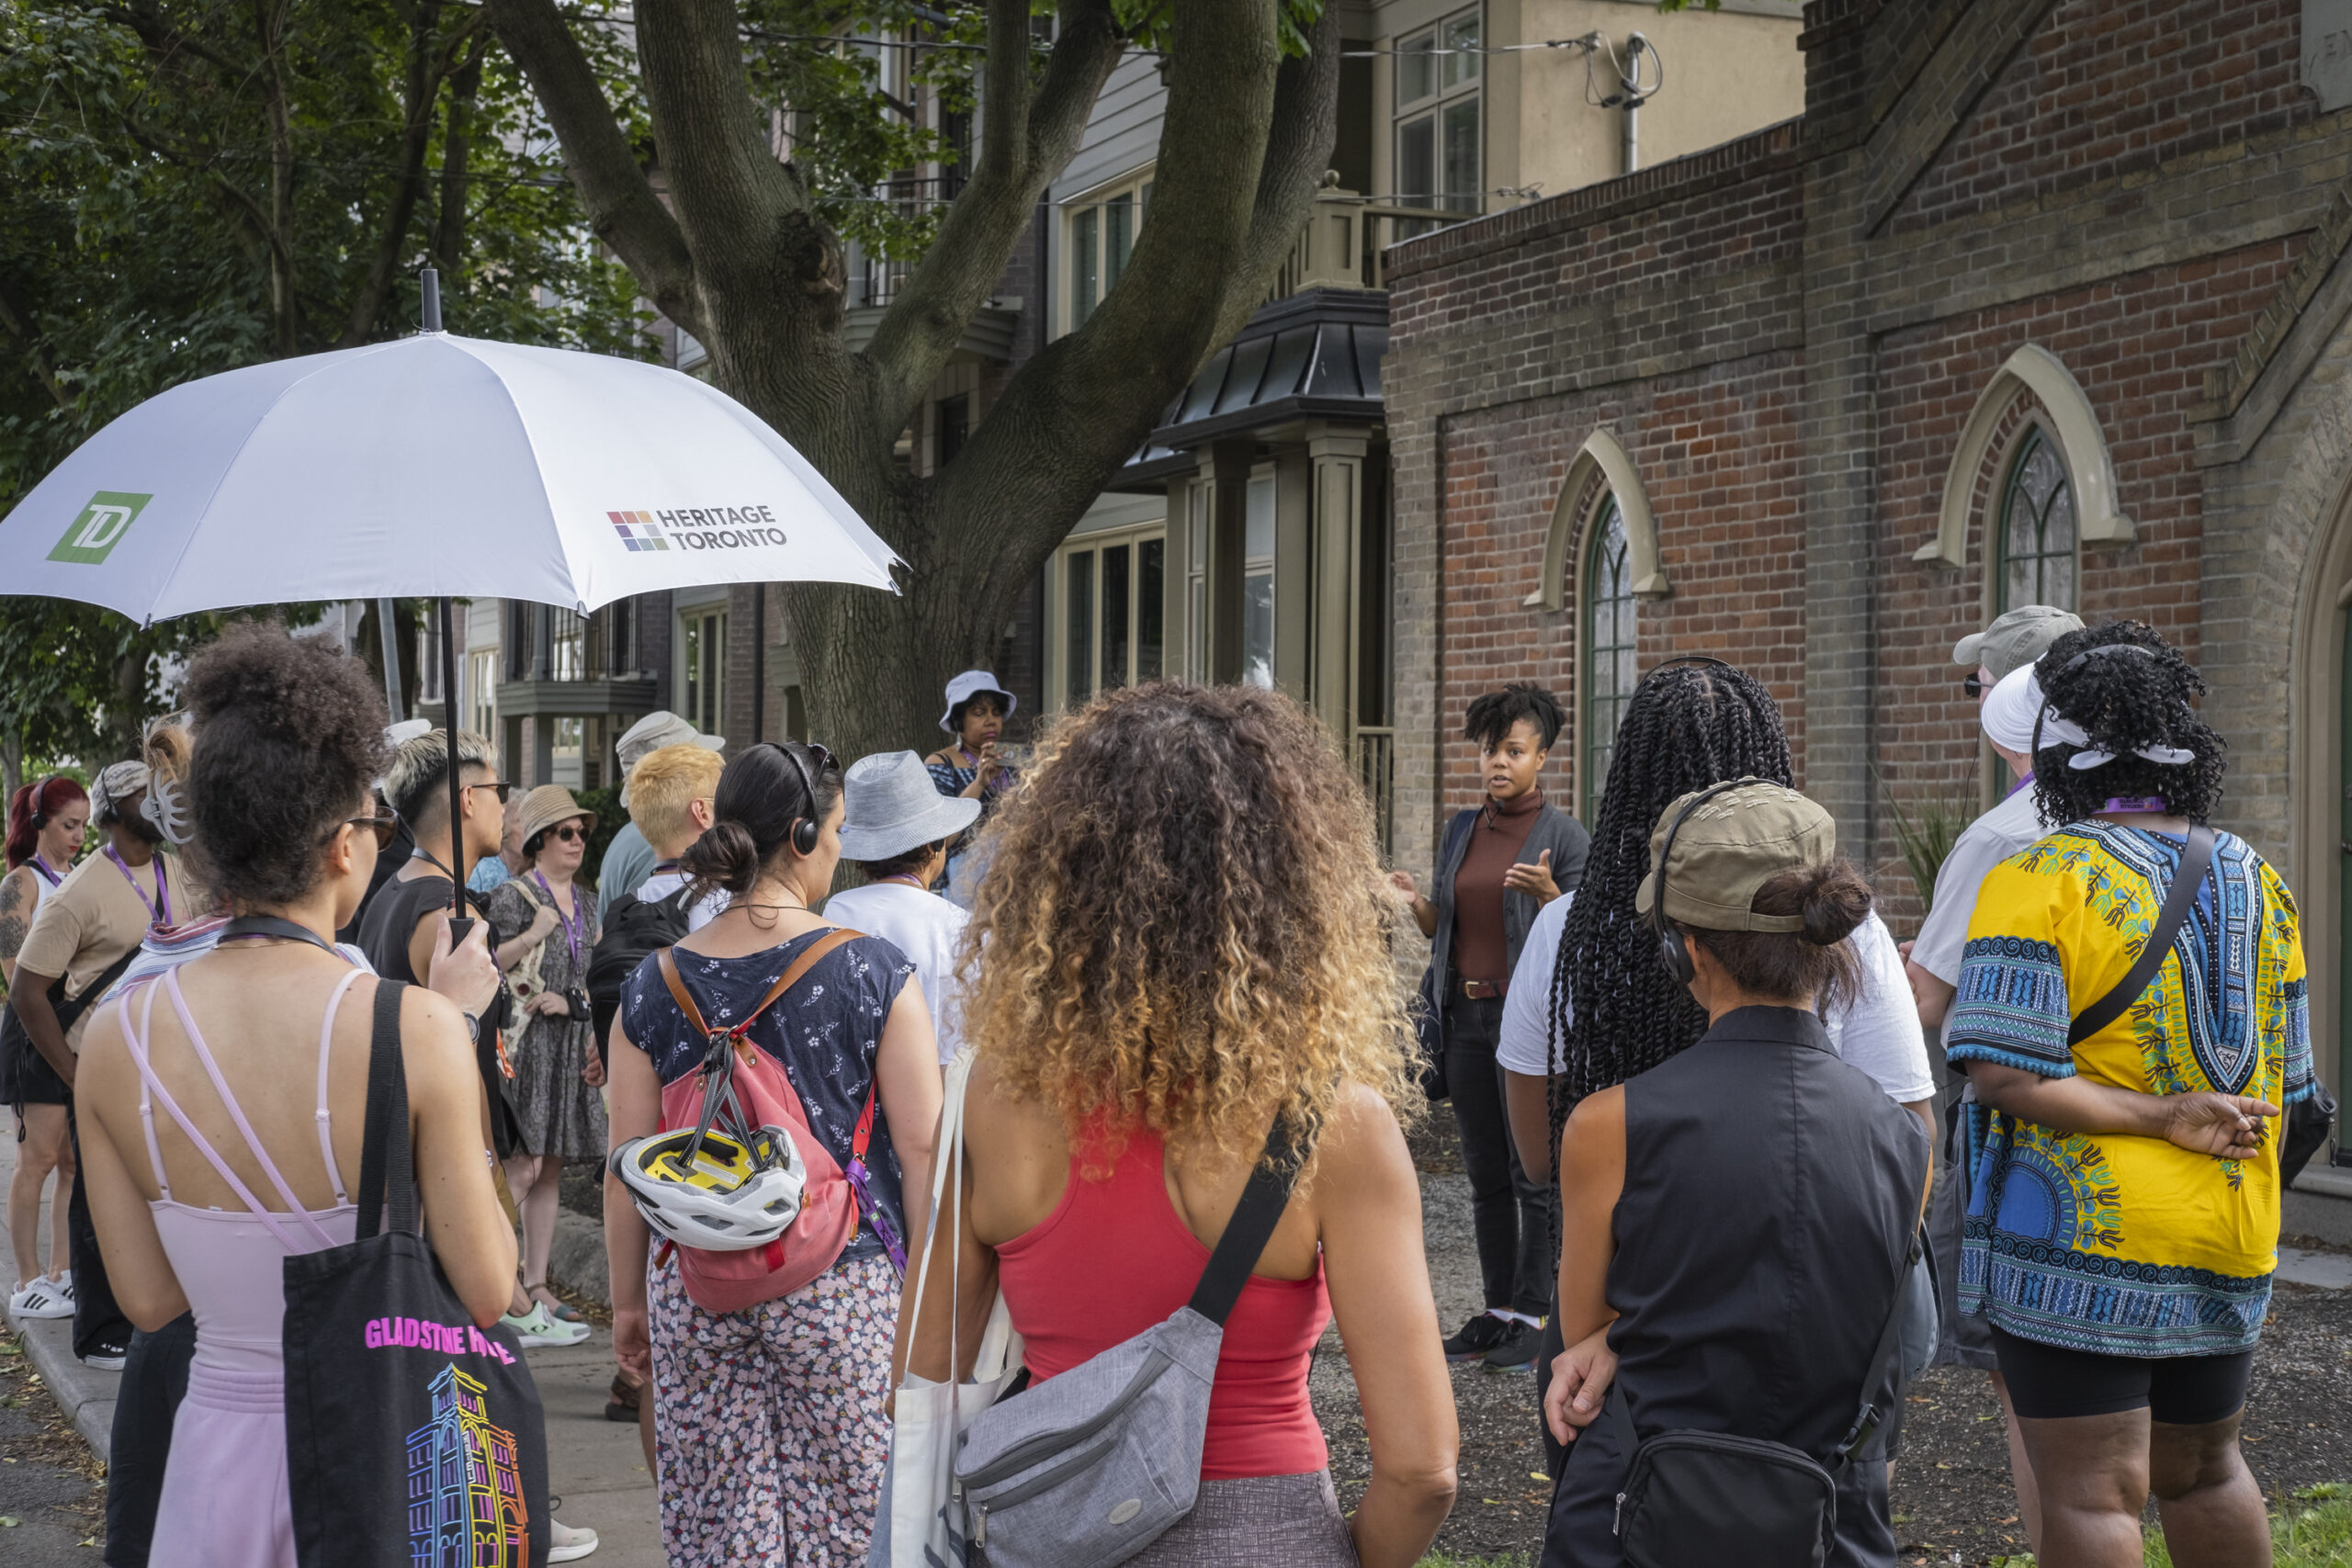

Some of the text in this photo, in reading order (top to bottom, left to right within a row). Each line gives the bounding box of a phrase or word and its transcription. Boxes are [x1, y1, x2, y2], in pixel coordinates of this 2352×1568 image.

[72, 504, 132, 548] TD
[656, 505, 776, 527] HERITAGE
[670, 527, 787, 550] TORONTO
